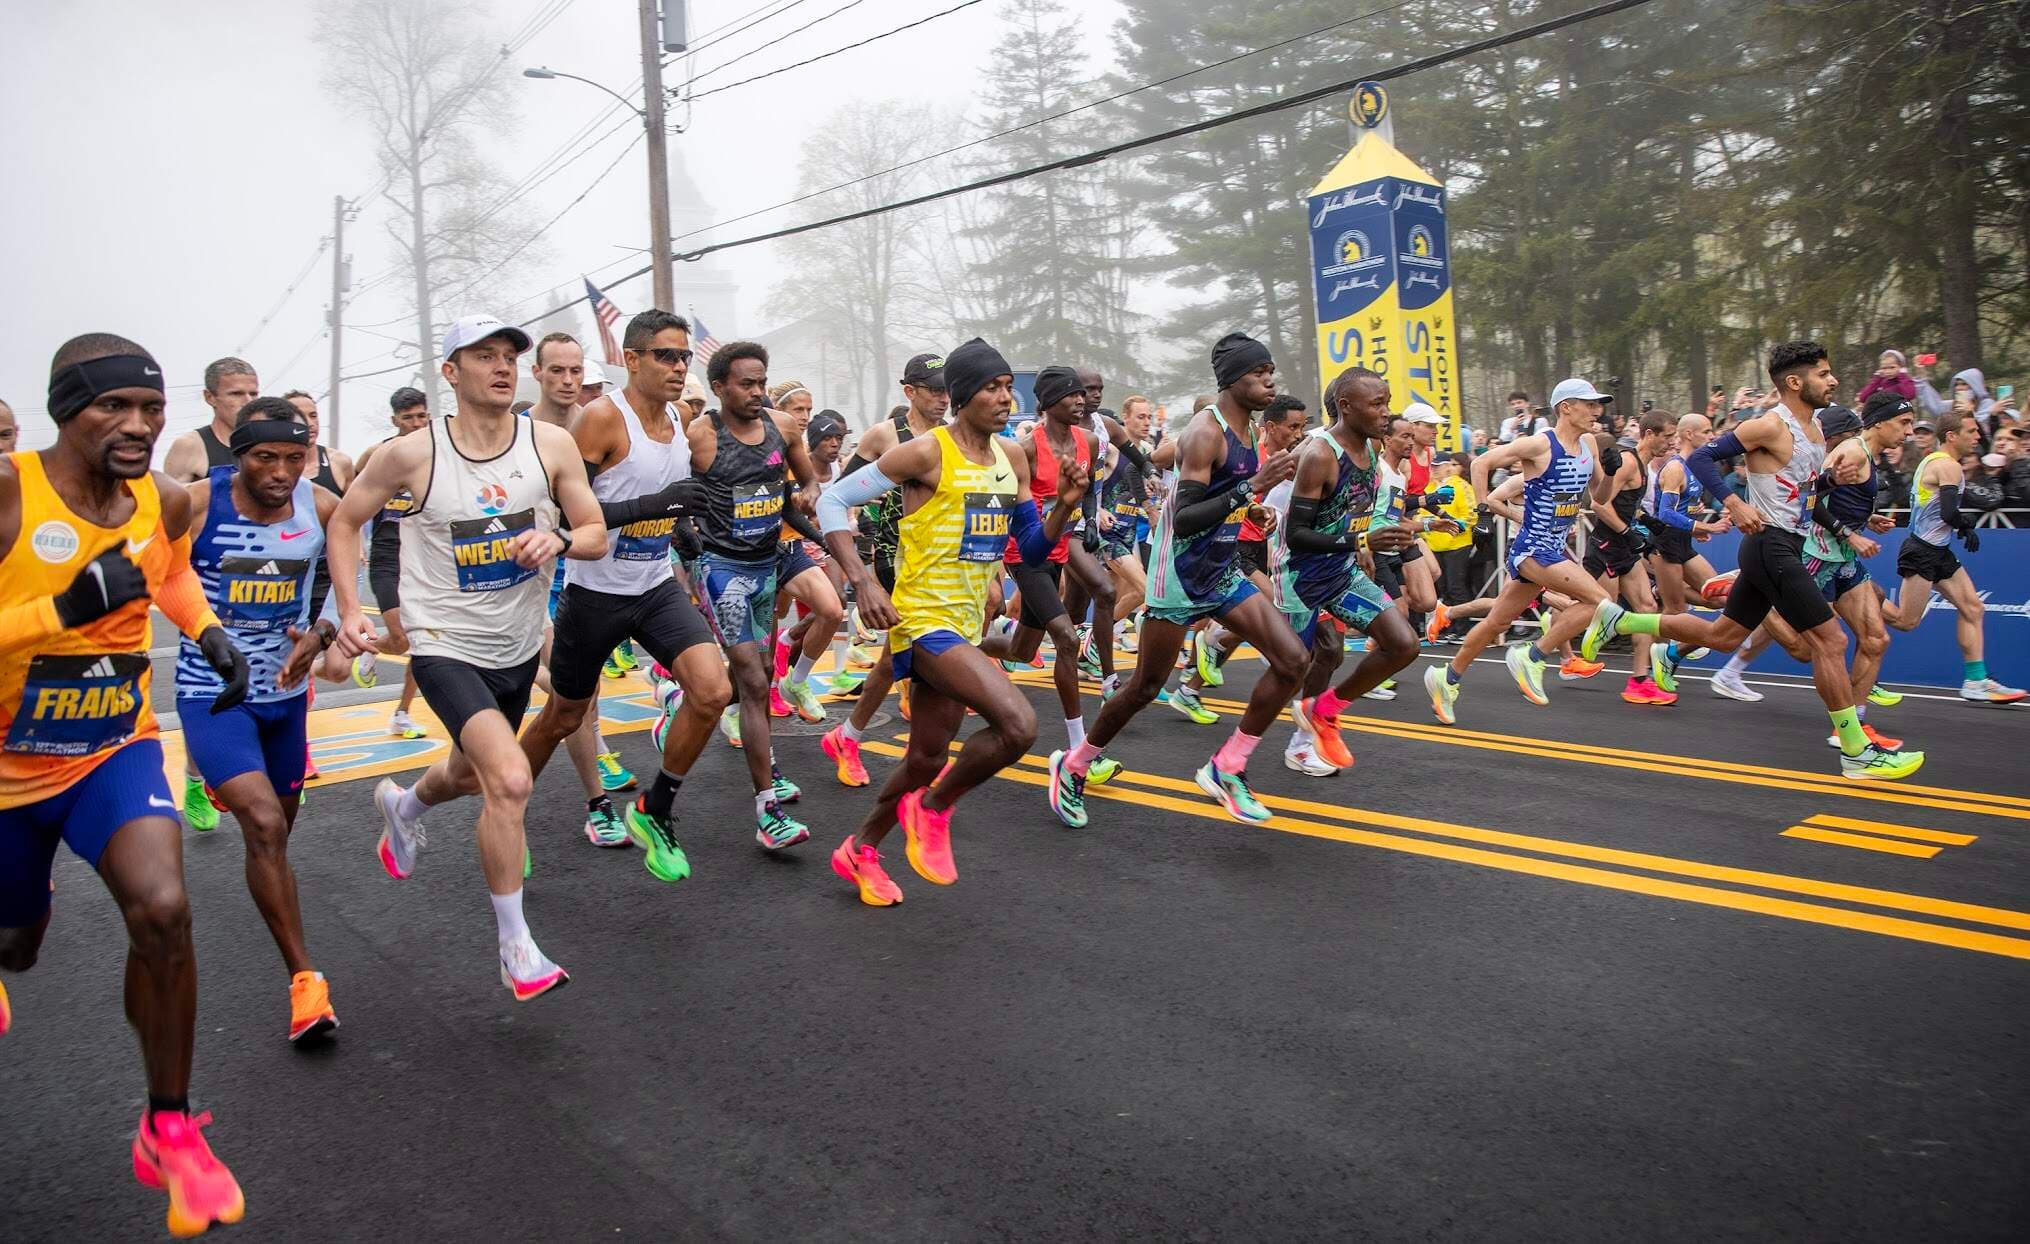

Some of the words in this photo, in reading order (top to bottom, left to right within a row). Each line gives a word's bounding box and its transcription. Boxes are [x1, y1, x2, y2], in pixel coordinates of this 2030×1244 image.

[1328, 328, 1364, 368] S
[1371, 336, 1388, 382] HO
[1435, 336, 1453, 452] HOPKINT
[454, 537, 516, 567] WEAV
[229, 579, 297, 604] KITATA
